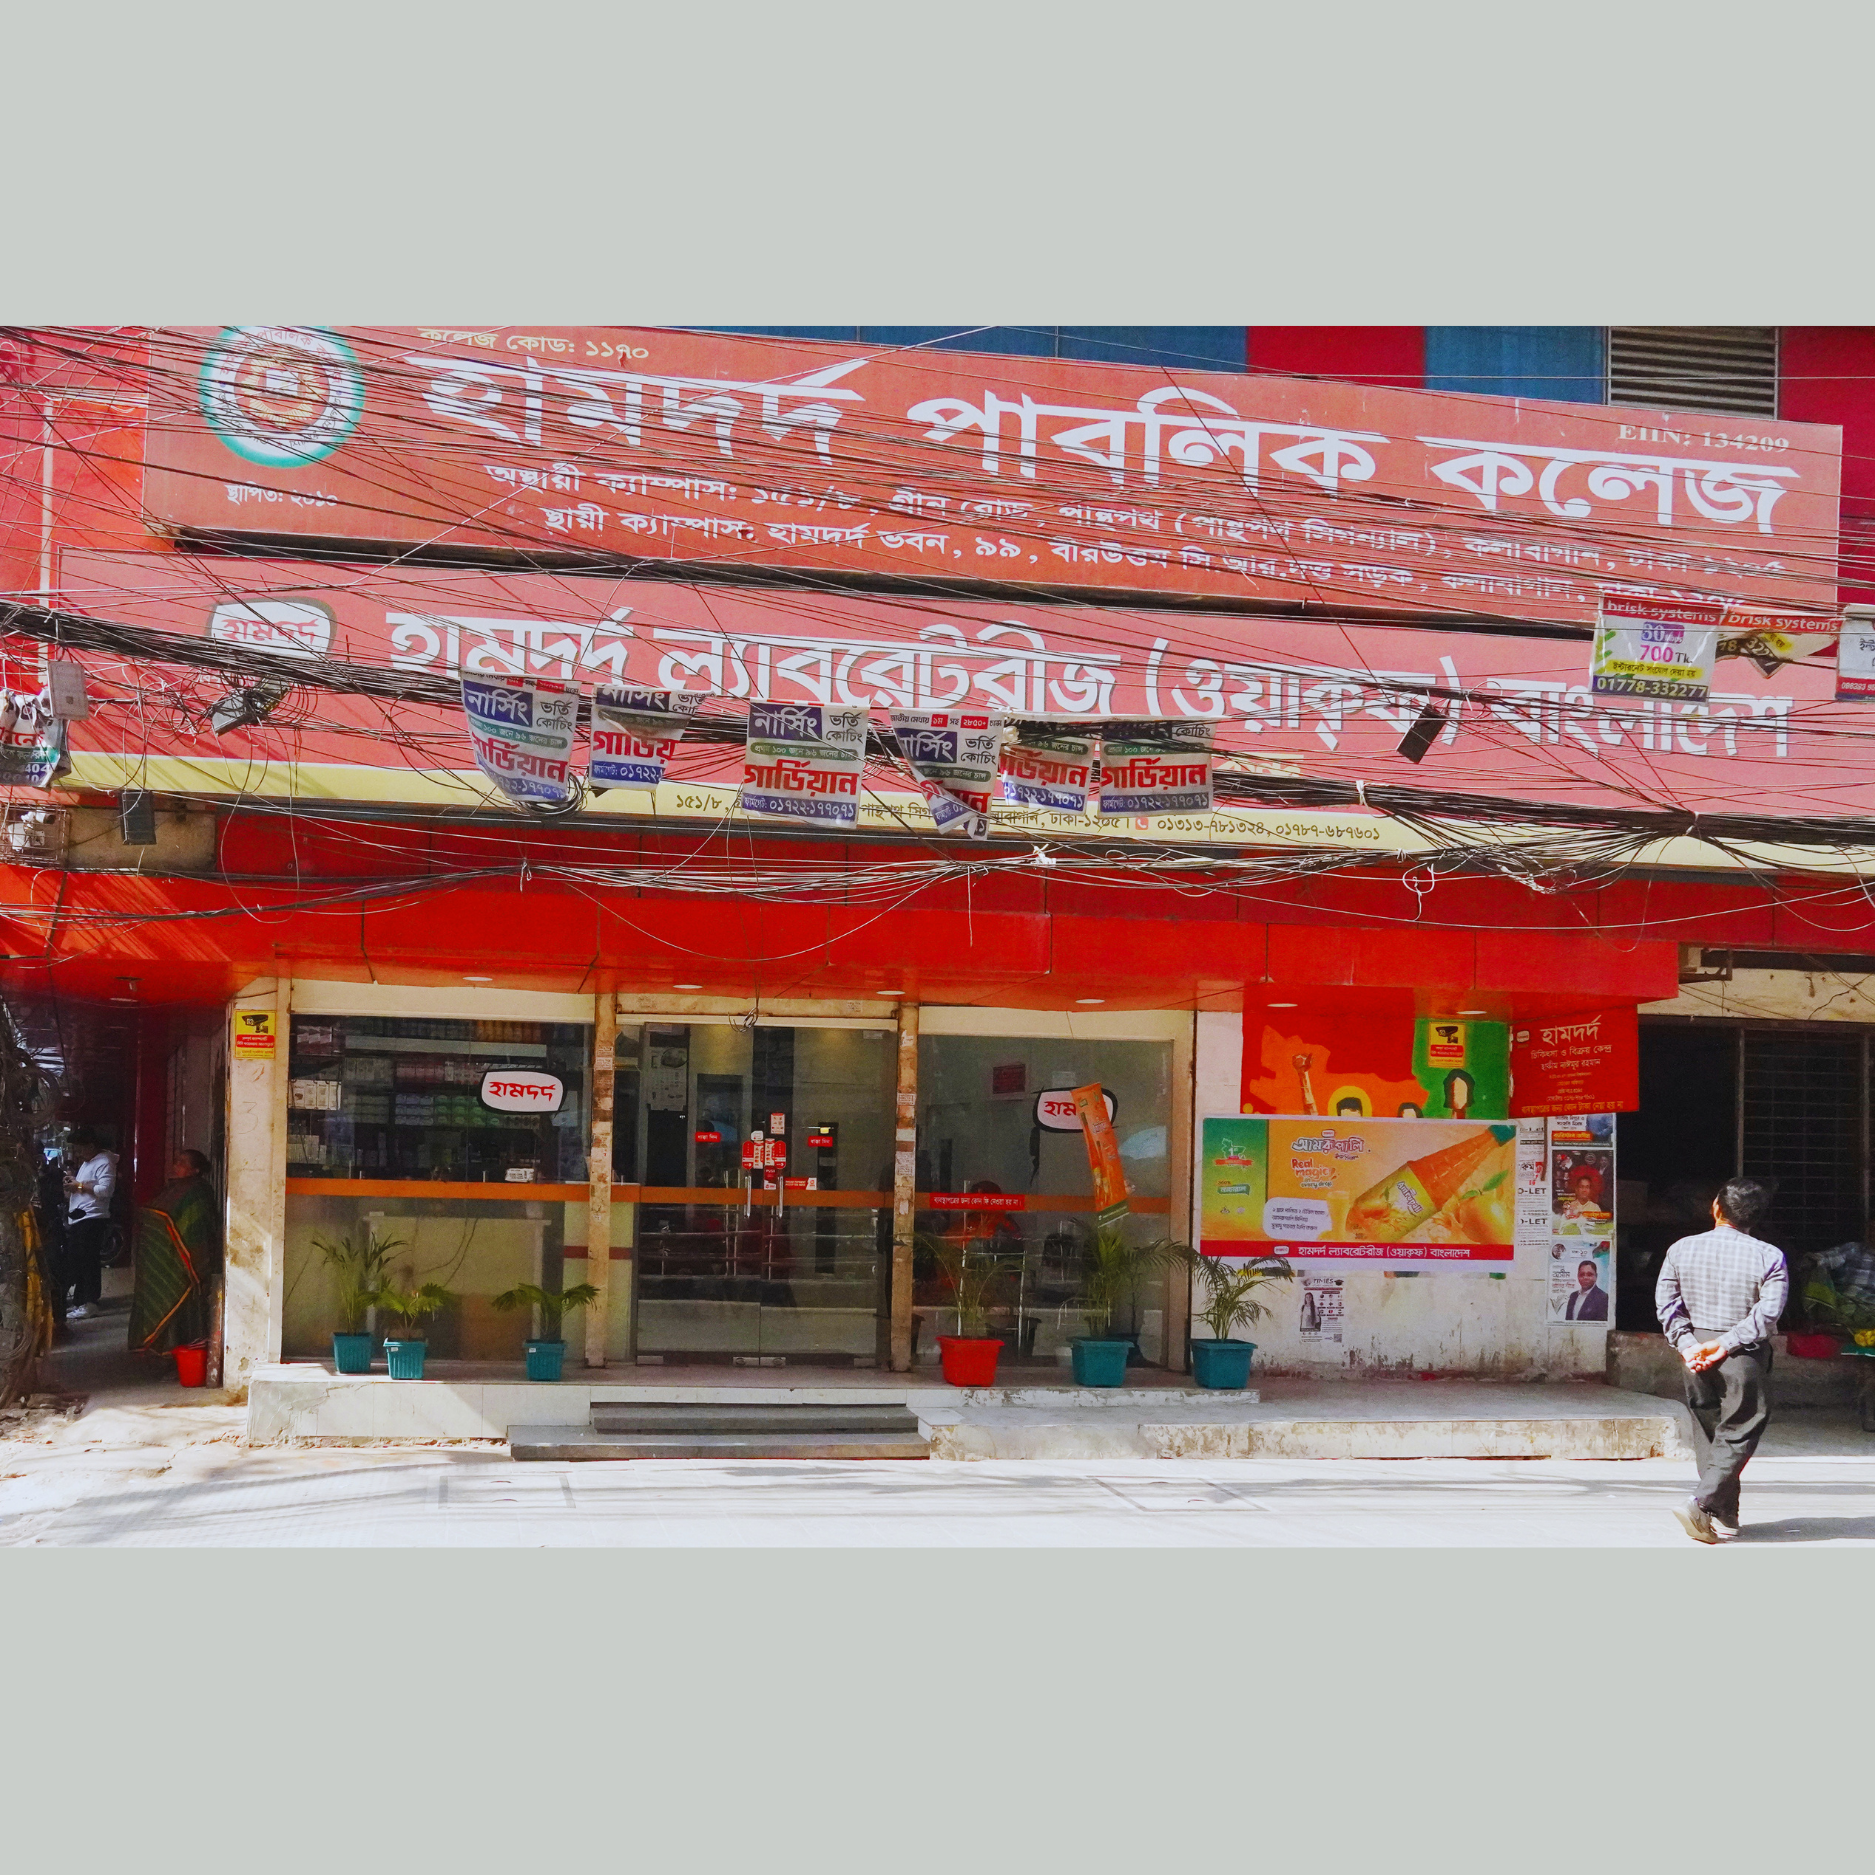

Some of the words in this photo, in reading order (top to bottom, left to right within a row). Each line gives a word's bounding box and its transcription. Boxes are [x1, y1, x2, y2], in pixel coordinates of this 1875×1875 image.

[417, 327, 500, 350] কলেজ
[403, 355, 868, 466] হামদর্দ
[906, 386, 1389, 501] পাবলিক
[1416, 434, 1800, 536] কলেজ
[1702, 430, 1790, 453] 134209
[764, 521, 872, 549] হামদর্দ
[1775, 616, 1838, 631] systems
[1640, 645, 1674, 663] 700
[385, 607, 638, 684] হামদর্দ
[1497, 681, 1793, 757] বাংলাদেশ
[1596, 677, 1708, 698] 01778-332277
[464, 688, 530, 726] নার্সিং
[540, 700, 573, 716] ভর্তি
[536, 717, 574, 733] কোচিং
[752, 706, 820, 740] নার্সিং
[829, 711, 862, 727] ভর্তি
[825, 729, 863, 744] কোচিং
[965, 735, 997, 750] ভর্তি
[961, 751, 997, 766] কোচিং
[744, 759, 860, 797] গার্ডিয়ান
[1100, 757, 1208, 791] গার্ডিয়ান
[1540, 1015, 1602, 1046] হামদর্দ
[488, 1081, 556, 1102] হামদর্দ
[1291, 1158, 1313, 1169] Real
[1298, 1245, 1326, 1256] হামদর্দ
[1430, 1247, 1471, 1258] বাংলাদেশ
